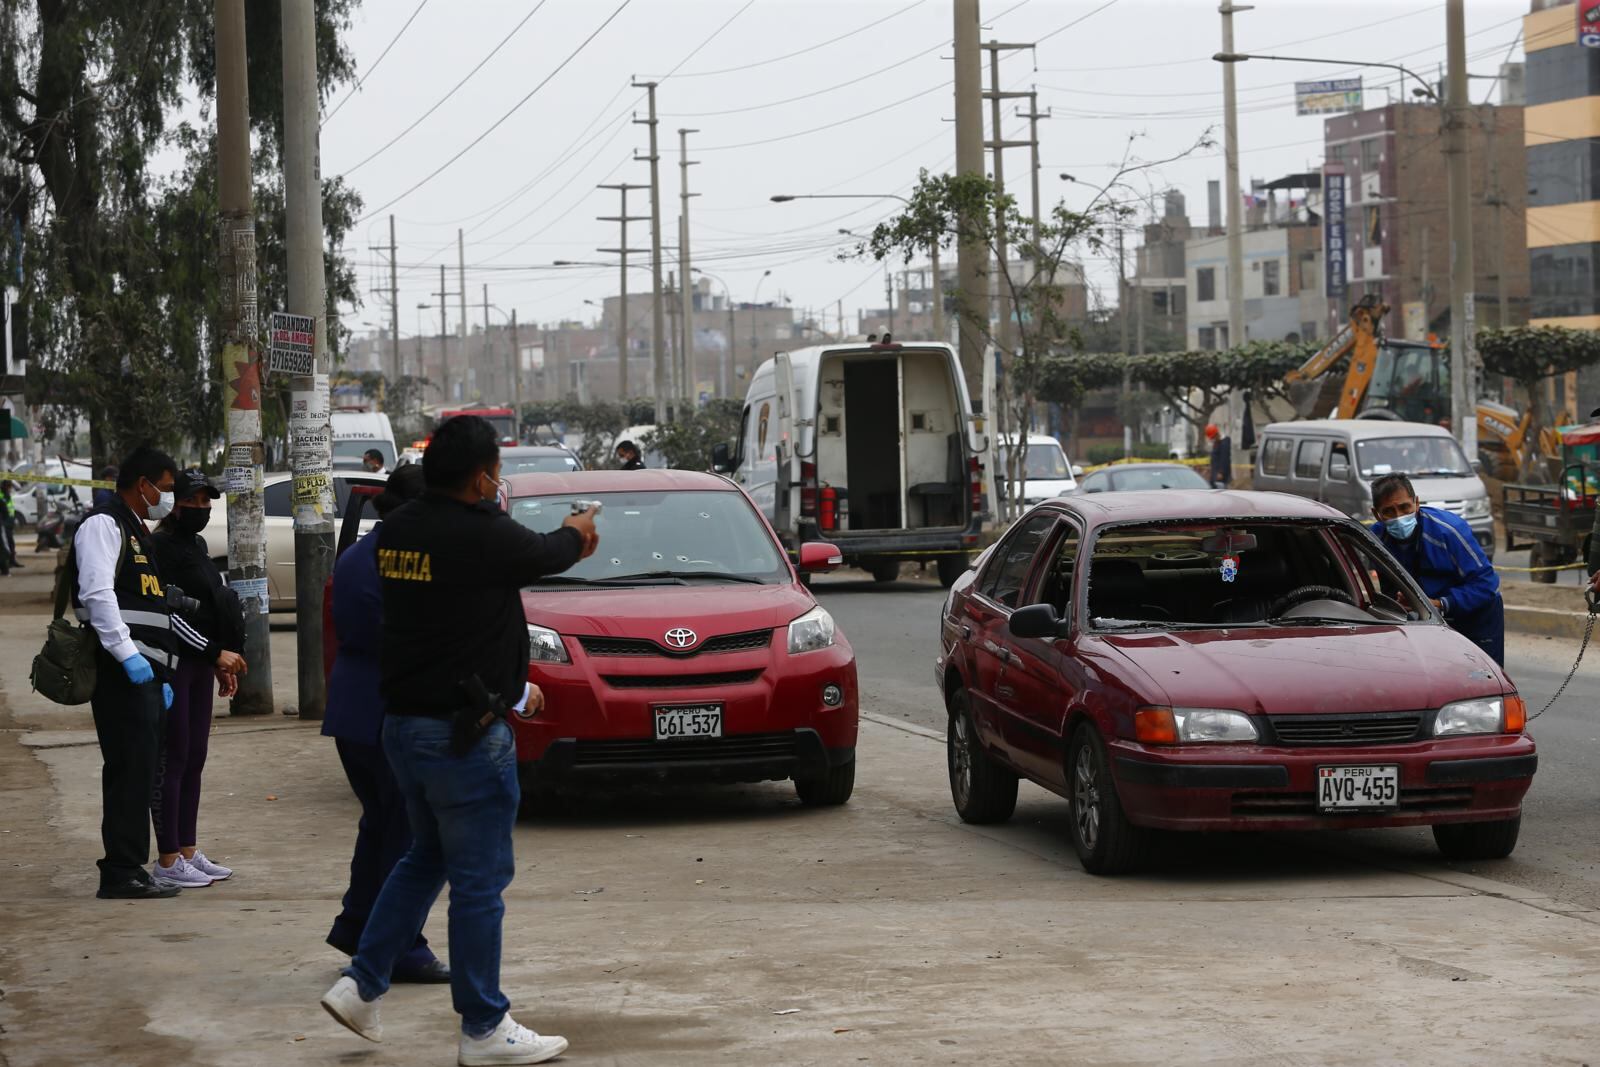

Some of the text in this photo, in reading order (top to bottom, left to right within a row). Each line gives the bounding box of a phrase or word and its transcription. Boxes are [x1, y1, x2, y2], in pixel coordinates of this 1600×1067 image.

[1328, 175, 1343, 286] HOSPEDAJE
[273, 314, 314, 333] CURANDERA
[272, 350, 312, 375] 971659289
[378, 548, 432, 582] POLICIA
[657, 714, 720, 736] C61-537
[1343, 768, 1373, 777] PERU
[1322, 776, 1395, 802] AYQ-455
